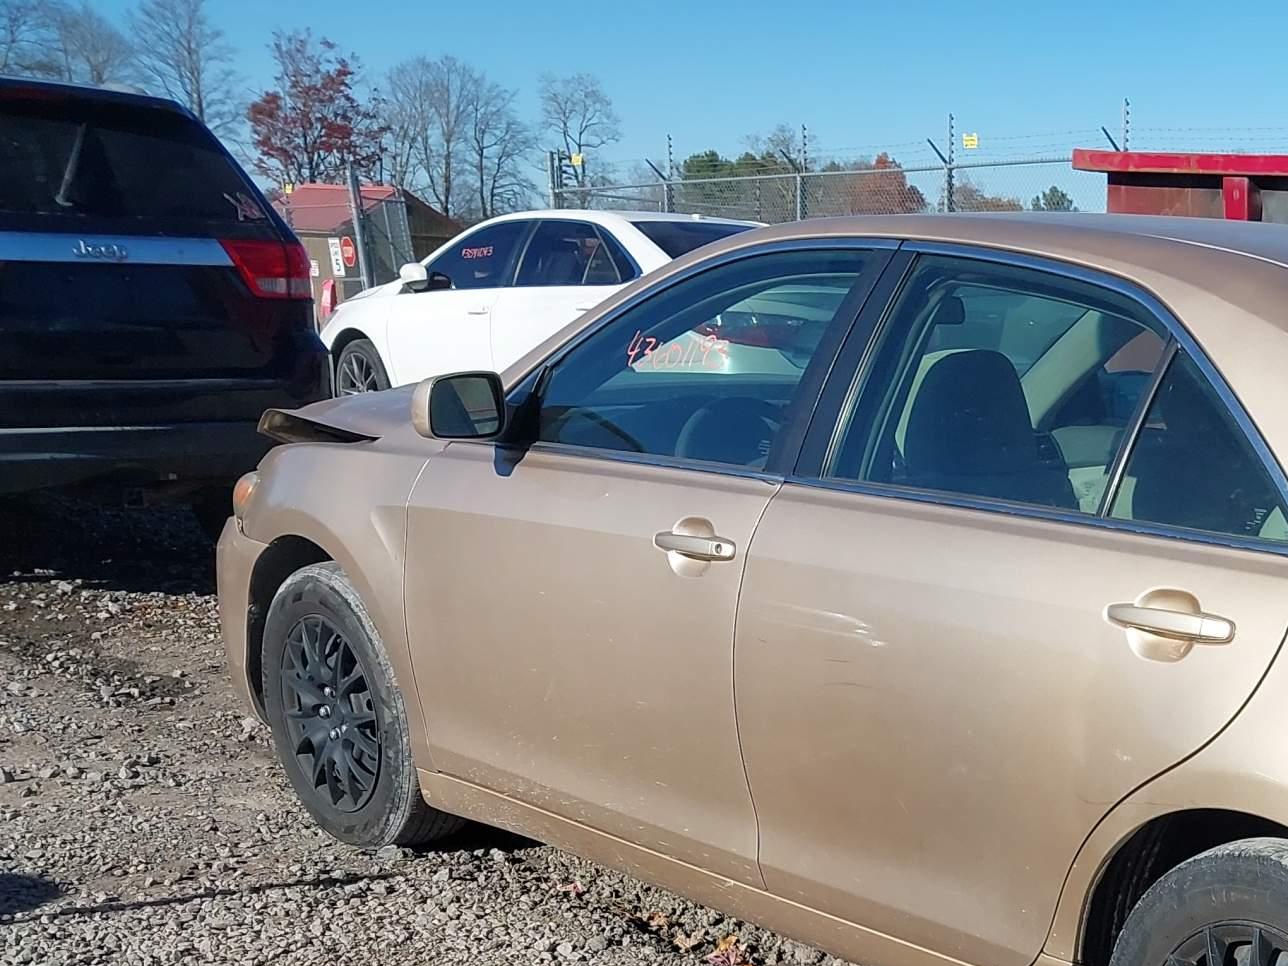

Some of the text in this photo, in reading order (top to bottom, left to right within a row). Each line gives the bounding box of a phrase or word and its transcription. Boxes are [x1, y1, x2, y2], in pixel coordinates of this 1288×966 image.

[72, 239, 127, 261] Jeep
[335, 258, 342, 272] 5
[627, 329, 730, 370] 43601193
